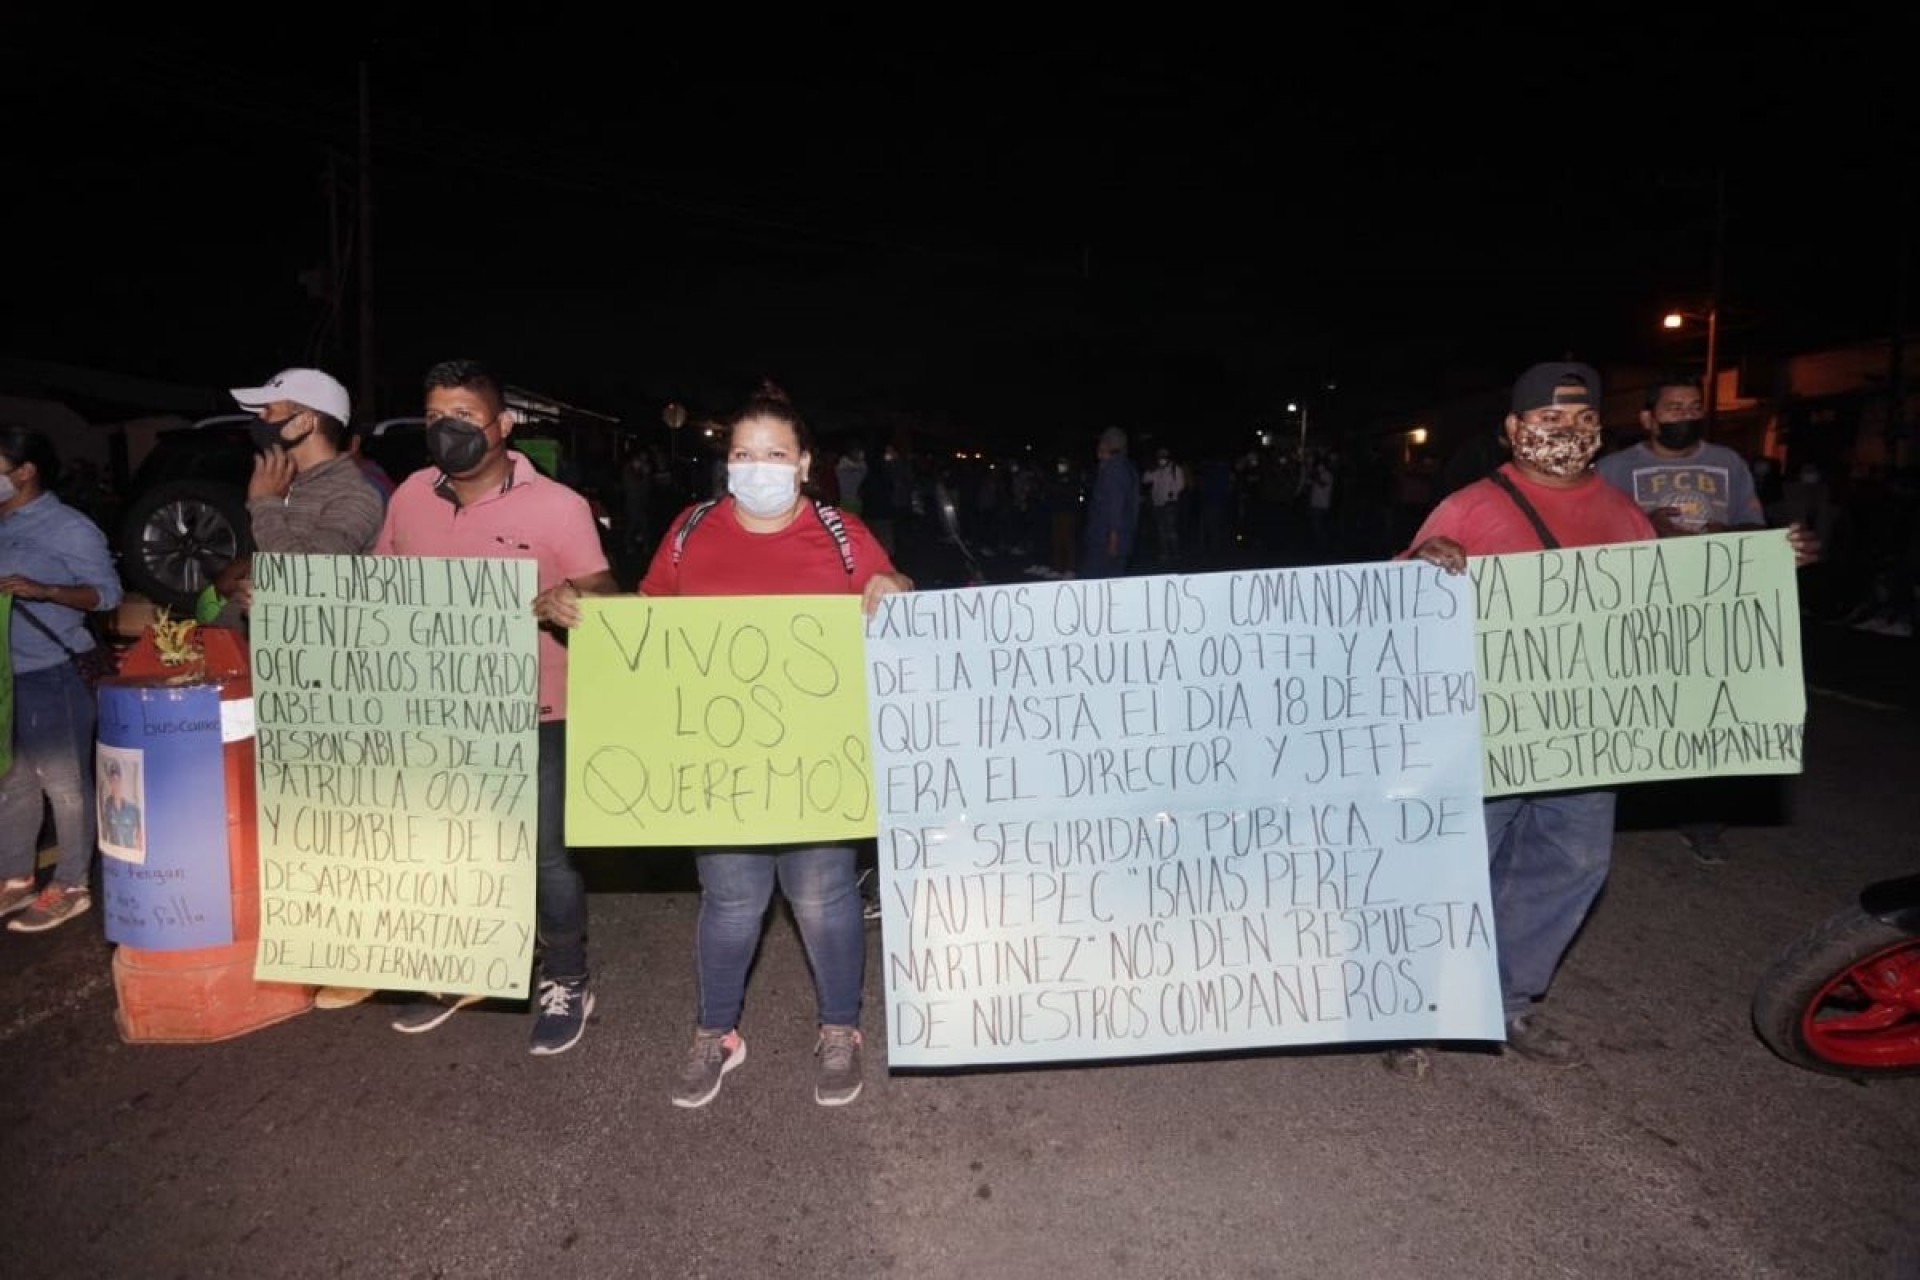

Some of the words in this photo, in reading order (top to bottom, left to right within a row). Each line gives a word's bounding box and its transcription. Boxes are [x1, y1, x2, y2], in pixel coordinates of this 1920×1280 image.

[446, 558, 521, 609] IVAN
[1053, 580, 1129, 637] QUE
[1138, 577, 1205, 634] LOS
[1230, 566, 1457, 627] COMANDANTES
[1470, 556, 1513, 620] YA
[1537, 544, 1673, 617] BASTA
[1697, 538, 1757, 598] DE
[257, 604, 390, 648] FUENTES
[598, 606, 839, 697] VIVOS
[1475, 620, 1594, 683] TANTA
[1605, 588, 1784, 679] CORRUPCION
[256, 649, 322, 690] OFIC.
[330, 650, 417, 693] CARLOS
[428, 651, 537, 697] RICARDO
[873, 658, 915, 696] DE
[932, 652, 972, 692] LA
[990, 639, 1182, 688] PATRULLA
[1200, 632, 1317, 676] 00777
[1339, 632, 1357, 675] Y
[1376, 626, 1445, 675] AL
[258, 692, 383, 726] CABELLO
[676, 685, 785, 748] LOS
[878, 700, 960, 754] QUE
[974, 692, 1100, 749] HASTA
[1120, 690, 1165, 737] EL
[1274, 676, 1309, 726] 18
[1323, 675, 1370, 721] DE
[1381, 671, 1476, 721] ENERO
[1481, 681, 1678, 736] DEVUELVAN
[1708, 680, 1741, 728] A
[258, 729, 437, 768] RESPONSABLES
[449, 736, 481, 769] DE
[494, 742, 524, 771] LA
[886, 758, 967, 815] ERA
[985, 756, 1038, 803] EL
[1046, 736, 1237, 798] DIRECTOR
[1266, 735, 1287, 777] Y
[1305, 723, 1434, 783] JEFE
[1488, 728, 1654, 787] NUESTROS
[260, 762, 408, 810] PATRULLA
[426, 771, 528, 815] 00777
[583, 735, 870, 830] QUEREMOS
[263, 804, 280, 845] Y
[294, 806, 424, 862] CULPABLE
[438, 818, 482, 863] DE
[498, 820, 530, 862] LA
[890, 827, 948, 870] DE
[973, 816, 1180, 872] SEGURIDAD
[1200, 802, 1371, 856] PUBLICA
[1393, 797, 1467, 844] DE
[264, 859, 457, 907] DESAPARICION
[468, 869, 512, 909] DE
[893, 870, 1114, 952] YAUTEPEC
[1264, 848, 1397, 909] PEREZ
[263, 939, 295, 966] DE
[266, 898, 363, 939] ROMAN
[374, 909, 508, 949] MARTINEZ
[516, 922, 530, 958] Y
[1110, 921, 1174, 980] NOS
[1190, 912, 1272, 971] DEN
[1283, 901, 1490, 958] RESPUESTA
[897, 1002, 950, 1049] DE
[972, 985, 1149, 1047] NUESTROS
